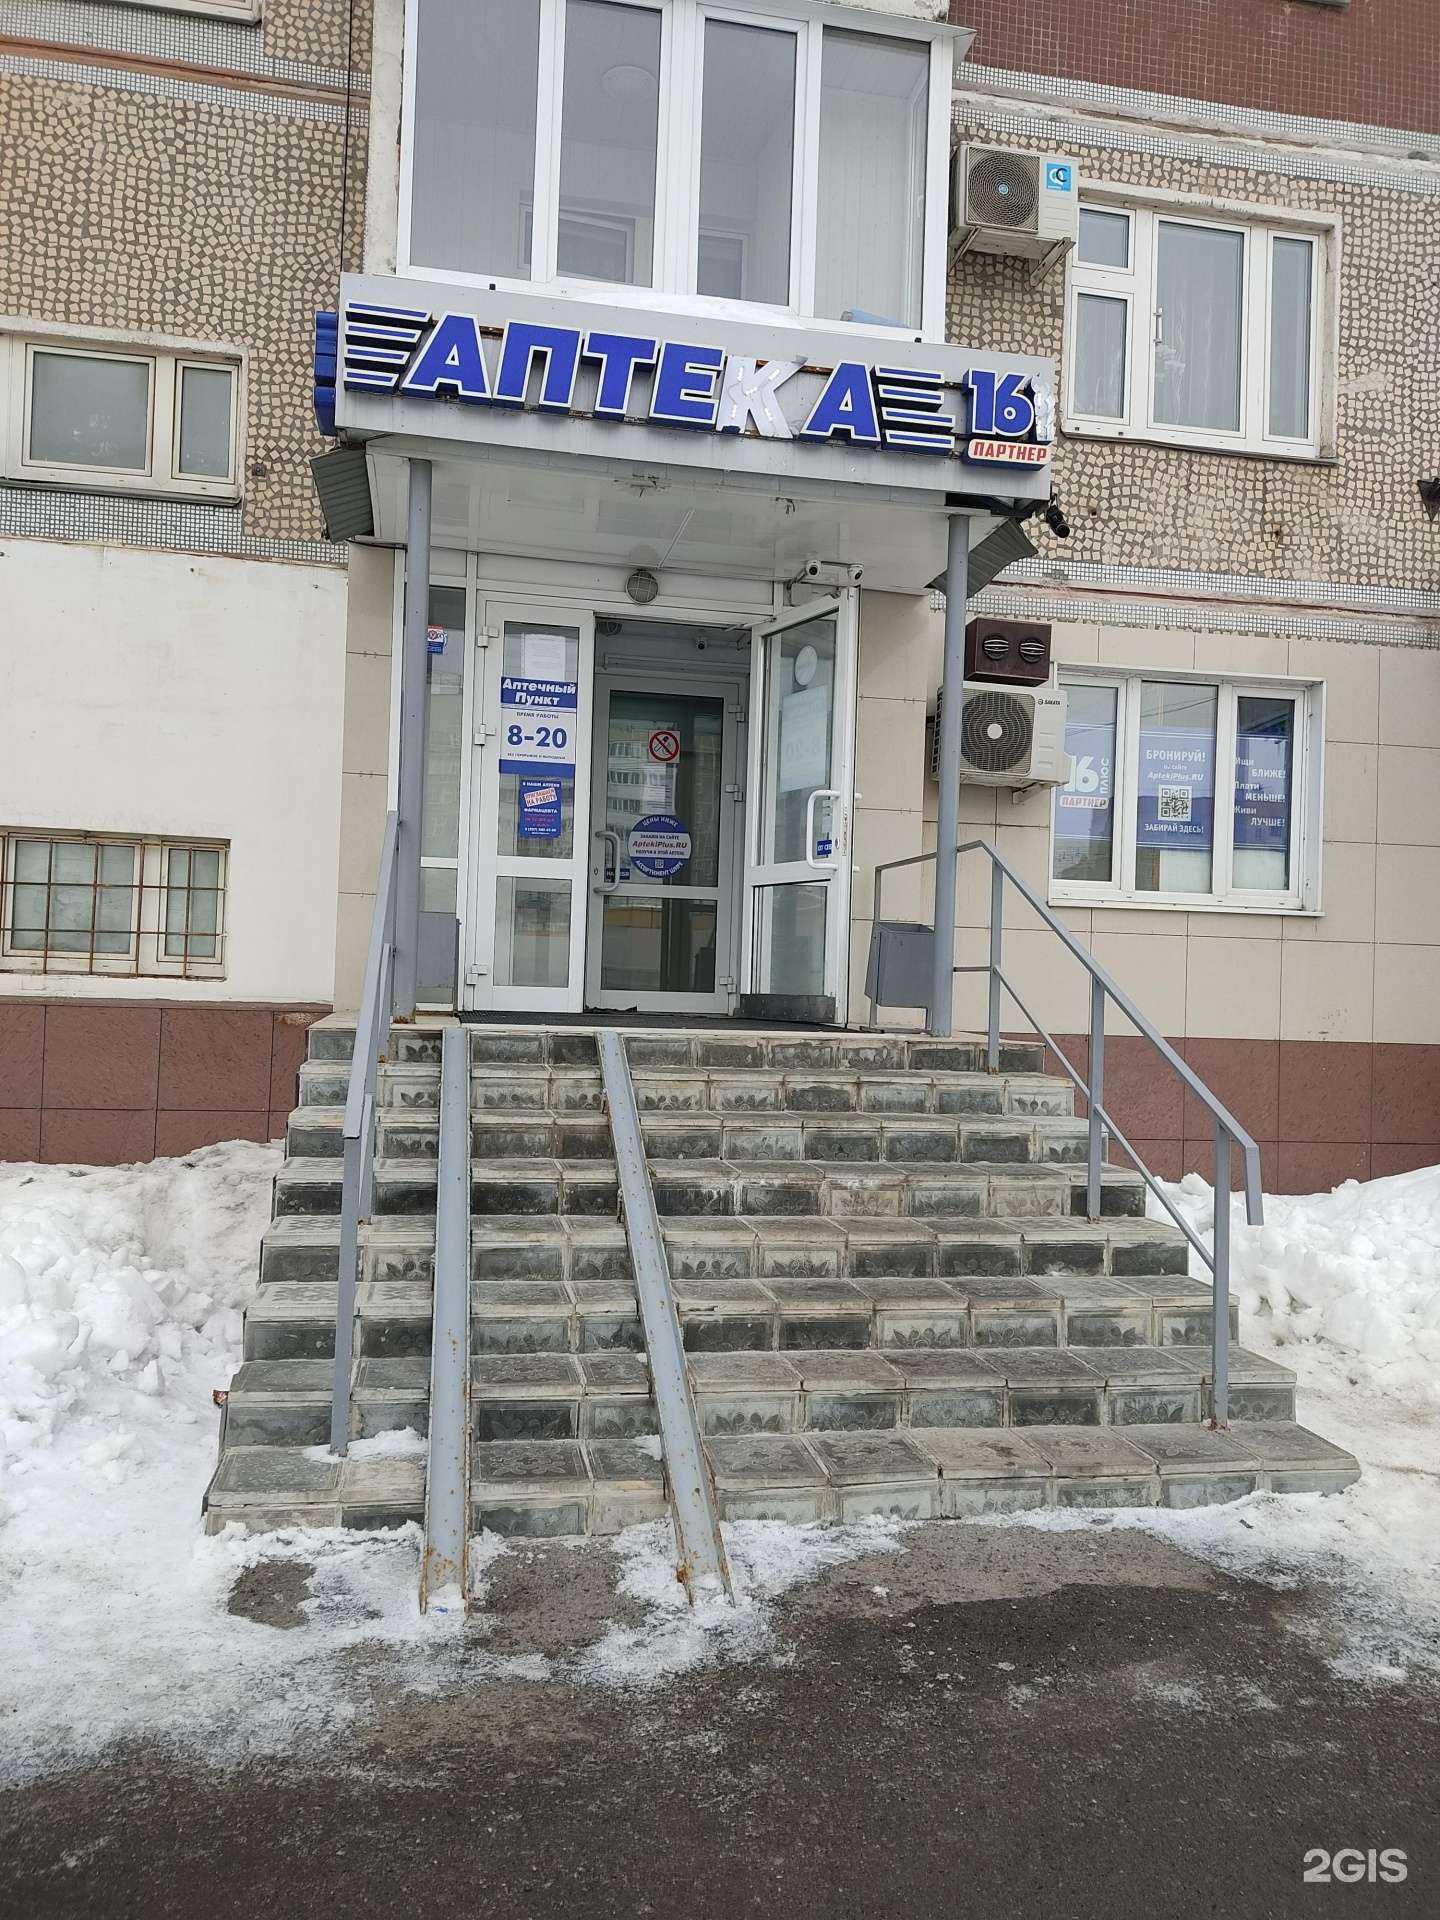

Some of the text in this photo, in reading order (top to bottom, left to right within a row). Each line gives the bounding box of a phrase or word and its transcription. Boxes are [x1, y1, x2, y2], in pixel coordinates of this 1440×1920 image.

[402, 312, 879, 442] АПТЕКА
[967, 368, 1035, 437] 16
[973, 441, 1047, 462] ПАРТНЕР
[502, 679, 577, 695] Аптечный
[514, 691, 560, 706] Пункт
[507, 724, 567, 749] 8-20
[1146, 749, 1206, 762] БРОНИРУЙ!
[1251, 768, 1286, 779] БЛИЖЕ!
[1061, 796, 1107, 808] ПАРТНЕР
[1245, 792, 1286, 803] МЕНЬШЕ!
[1144, 823, 1204, 834] ЗАБИРАЙ ЗДЕСЬ!
[1250, 817, 1286, 827] ЛУЧШЕ!
